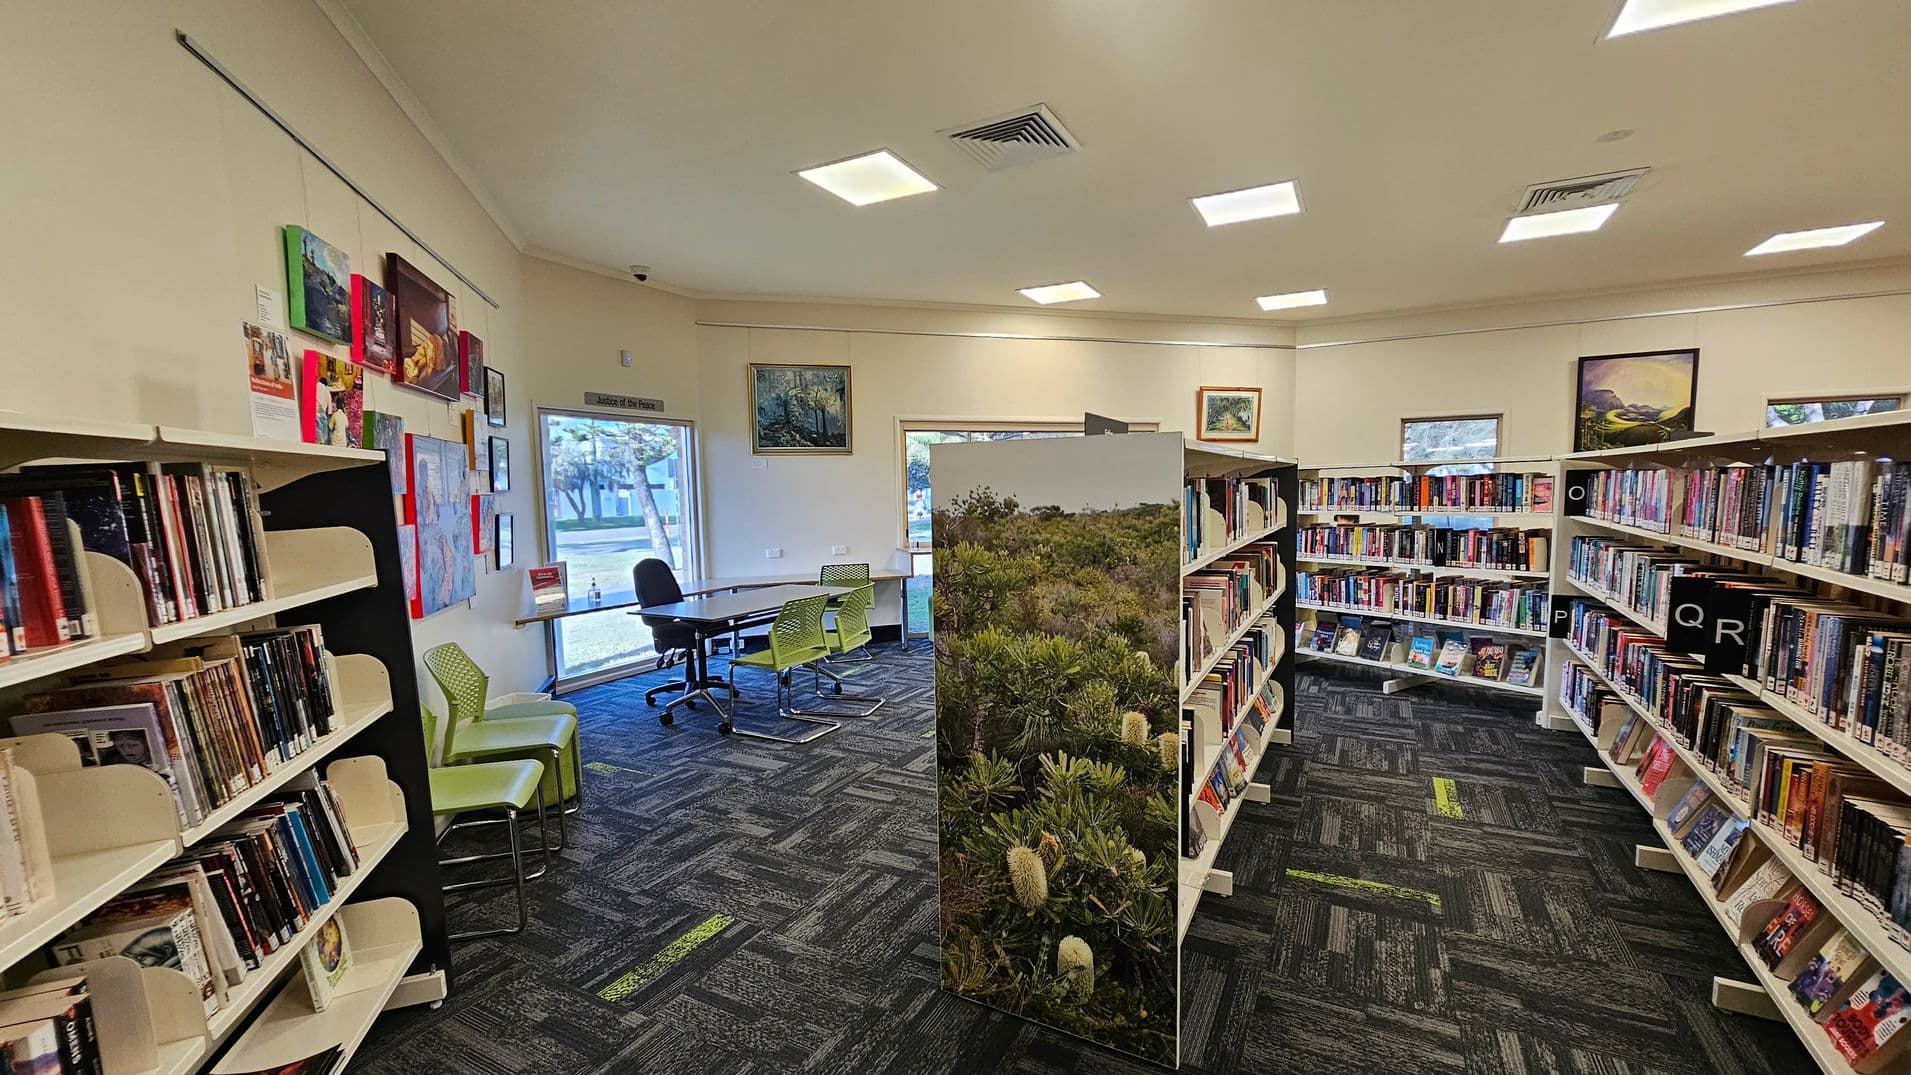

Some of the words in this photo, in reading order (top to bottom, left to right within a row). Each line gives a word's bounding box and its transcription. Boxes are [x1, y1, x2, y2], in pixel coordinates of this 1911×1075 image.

[596, 396, 618, 406] Justice
[620, 398, 625, 406] of
[628, 399, 637, 407] the
[638, 400, 656, 410] Peace
[1797, 470, 1806, 490] Kathy
[1568, 486, 1585, 500] O
[1880, 501, 1888, 528] TIME
[1437, 542, 1444, 554] N
[1554, 610, 1568, 624] P
[1675, 604, 1704, 628] Q
[1715, 619, 1745, 645] R
[1792, 893, 1814, 921] HOUSE
[1785, 913, 1797, 926] OF
[1762, 918, 1792, 958] FIRE
[1848, 1013, 1868, 1040] BODY
[66, 1021, 82, 1065] OMENS
